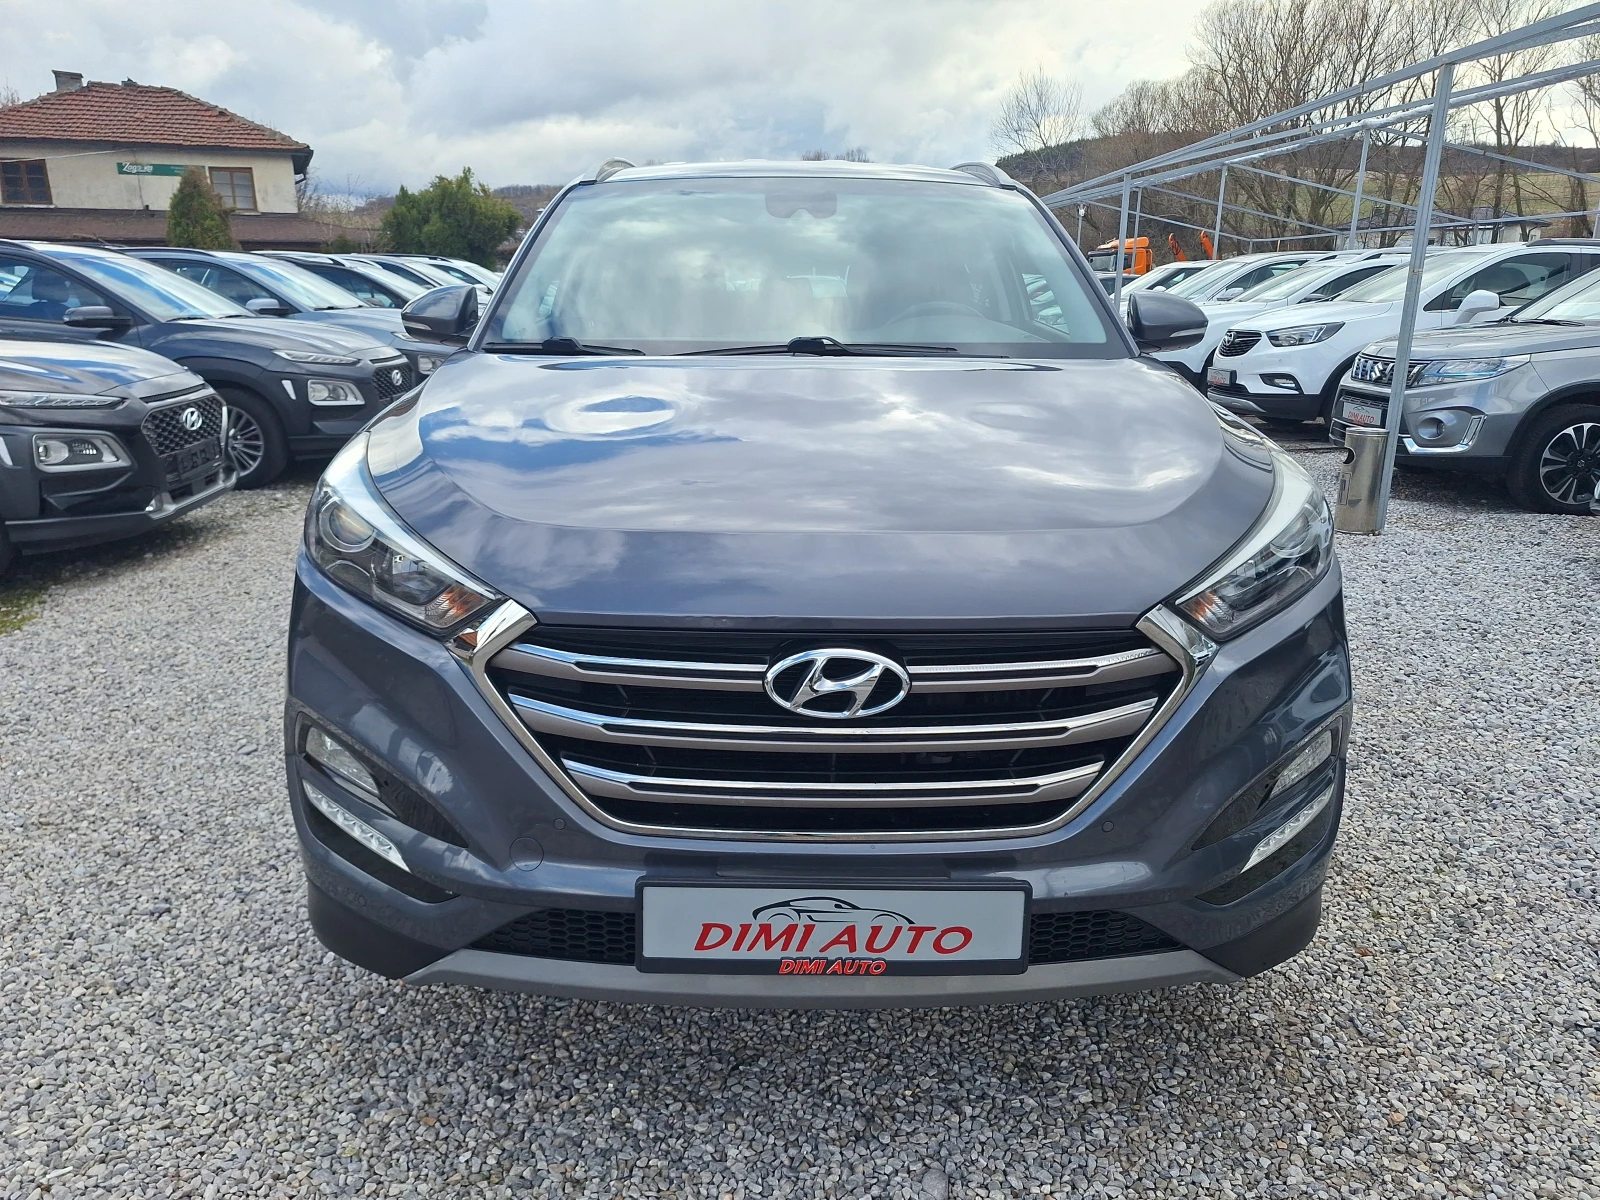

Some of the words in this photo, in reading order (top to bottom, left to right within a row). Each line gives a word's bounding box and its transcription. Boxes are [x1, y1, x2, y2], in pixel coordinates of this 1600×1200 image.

[1359, 414, 1375, 424] AUTO
[694, 923, 816, 952] DIMI
[819, 925, 973, 954] AUTO
[779, 959, 827, 975] DIMI
[826, 959, 887, 975] AUTO
